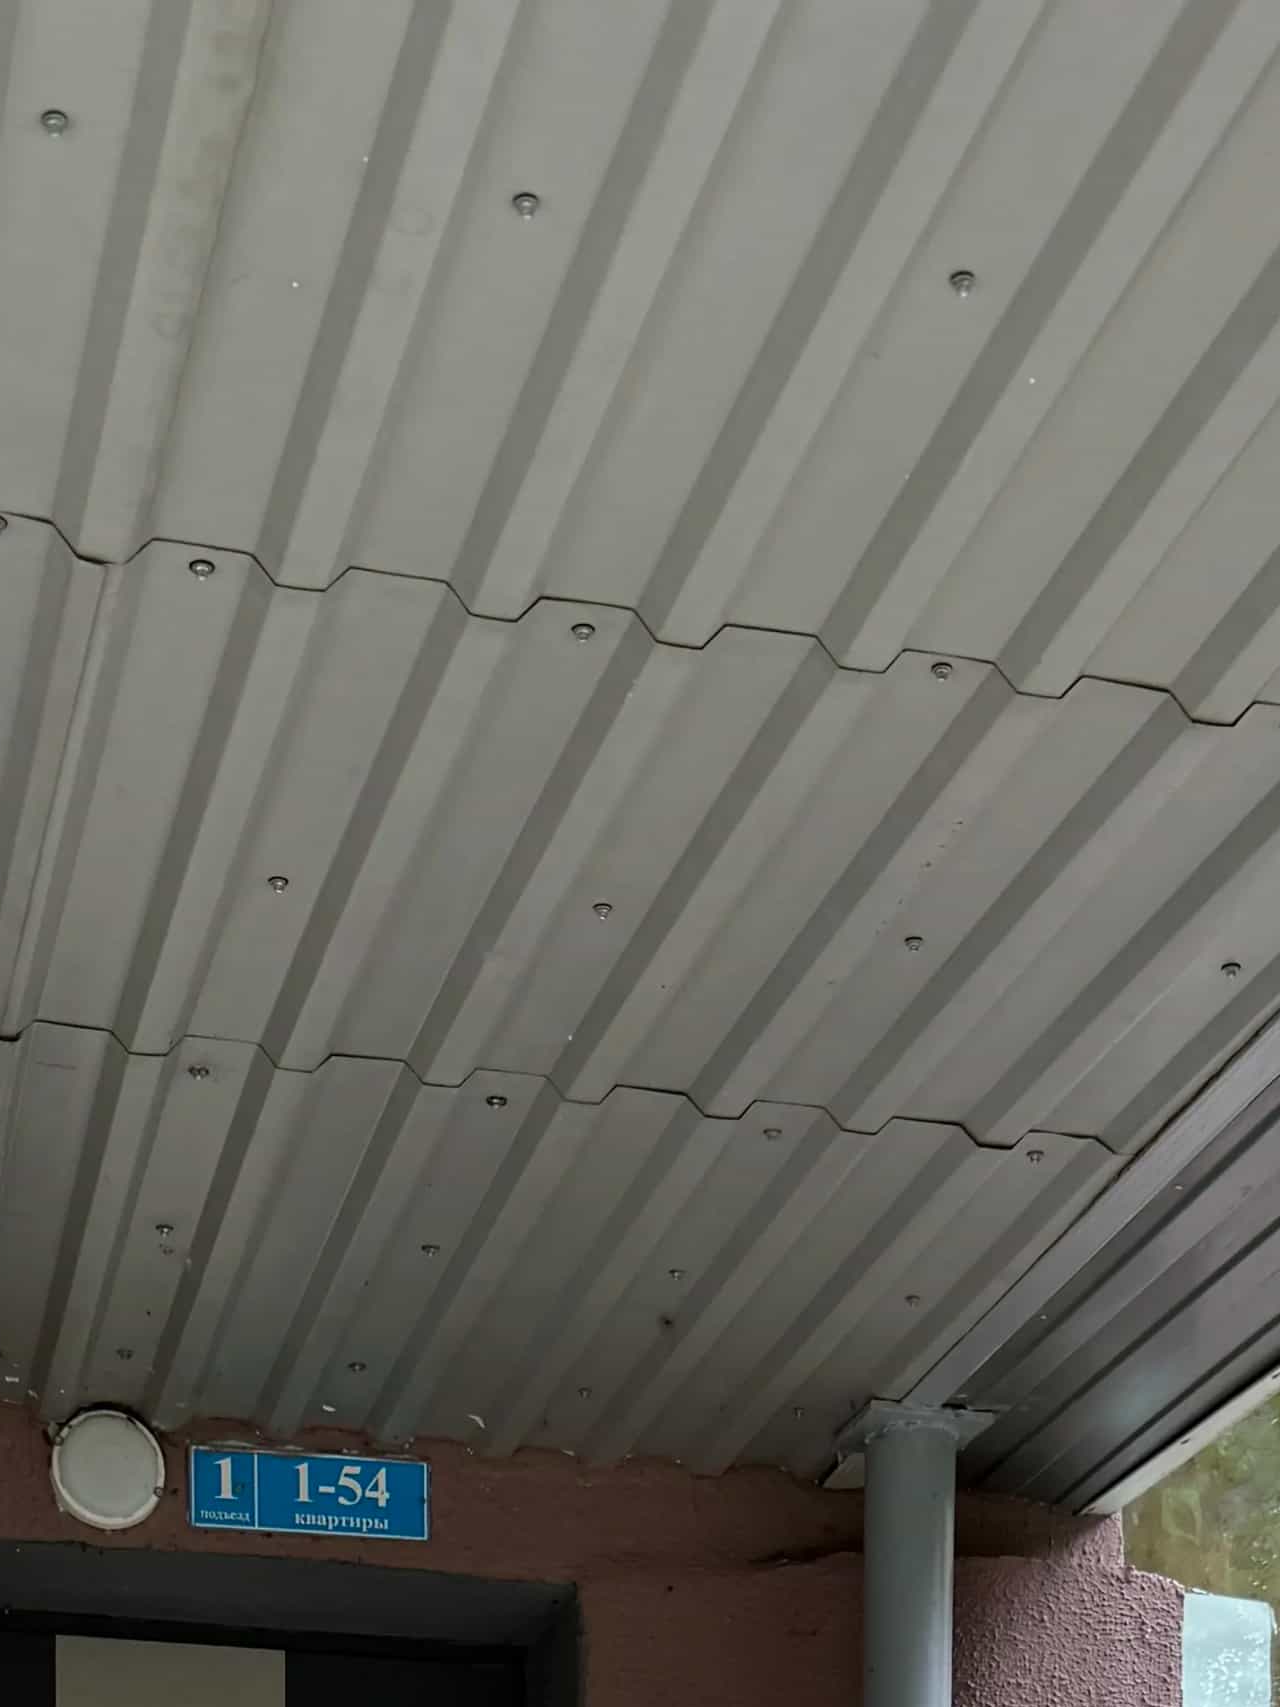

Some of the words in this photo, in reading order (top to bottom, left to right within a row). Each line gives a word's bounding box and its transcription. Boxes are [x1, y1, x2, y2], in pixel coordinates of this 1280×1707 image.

[213, 1456, 239, 1500] 1
[293, 1462, 390, 1508] 1-54
[200, 1509, 250, 1523] подъезд
[295, 1511, 389, 1532] квартиры
